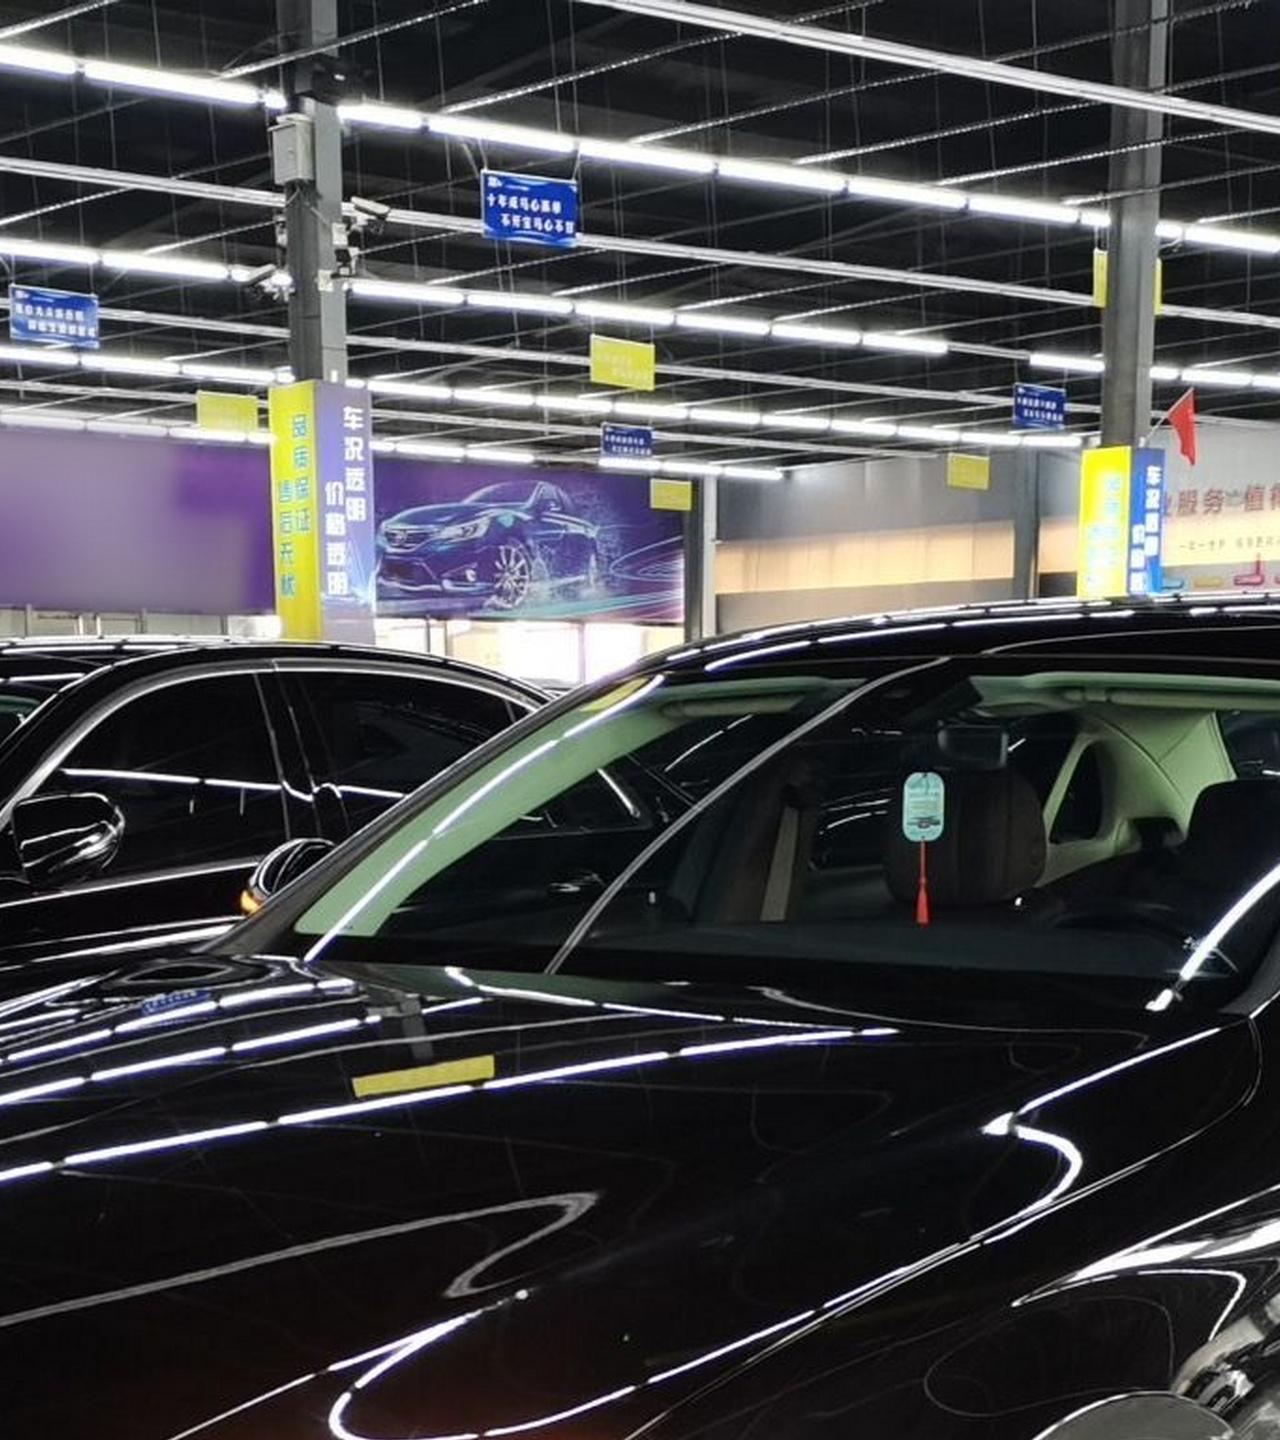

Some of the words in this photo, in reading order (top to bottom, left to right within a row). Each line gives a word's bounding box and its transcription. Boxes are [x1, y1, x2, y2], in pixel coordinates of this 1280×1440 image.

[343, 406, 366, 521] 车况透明
[325, 481, 347, 595] 价格透明
